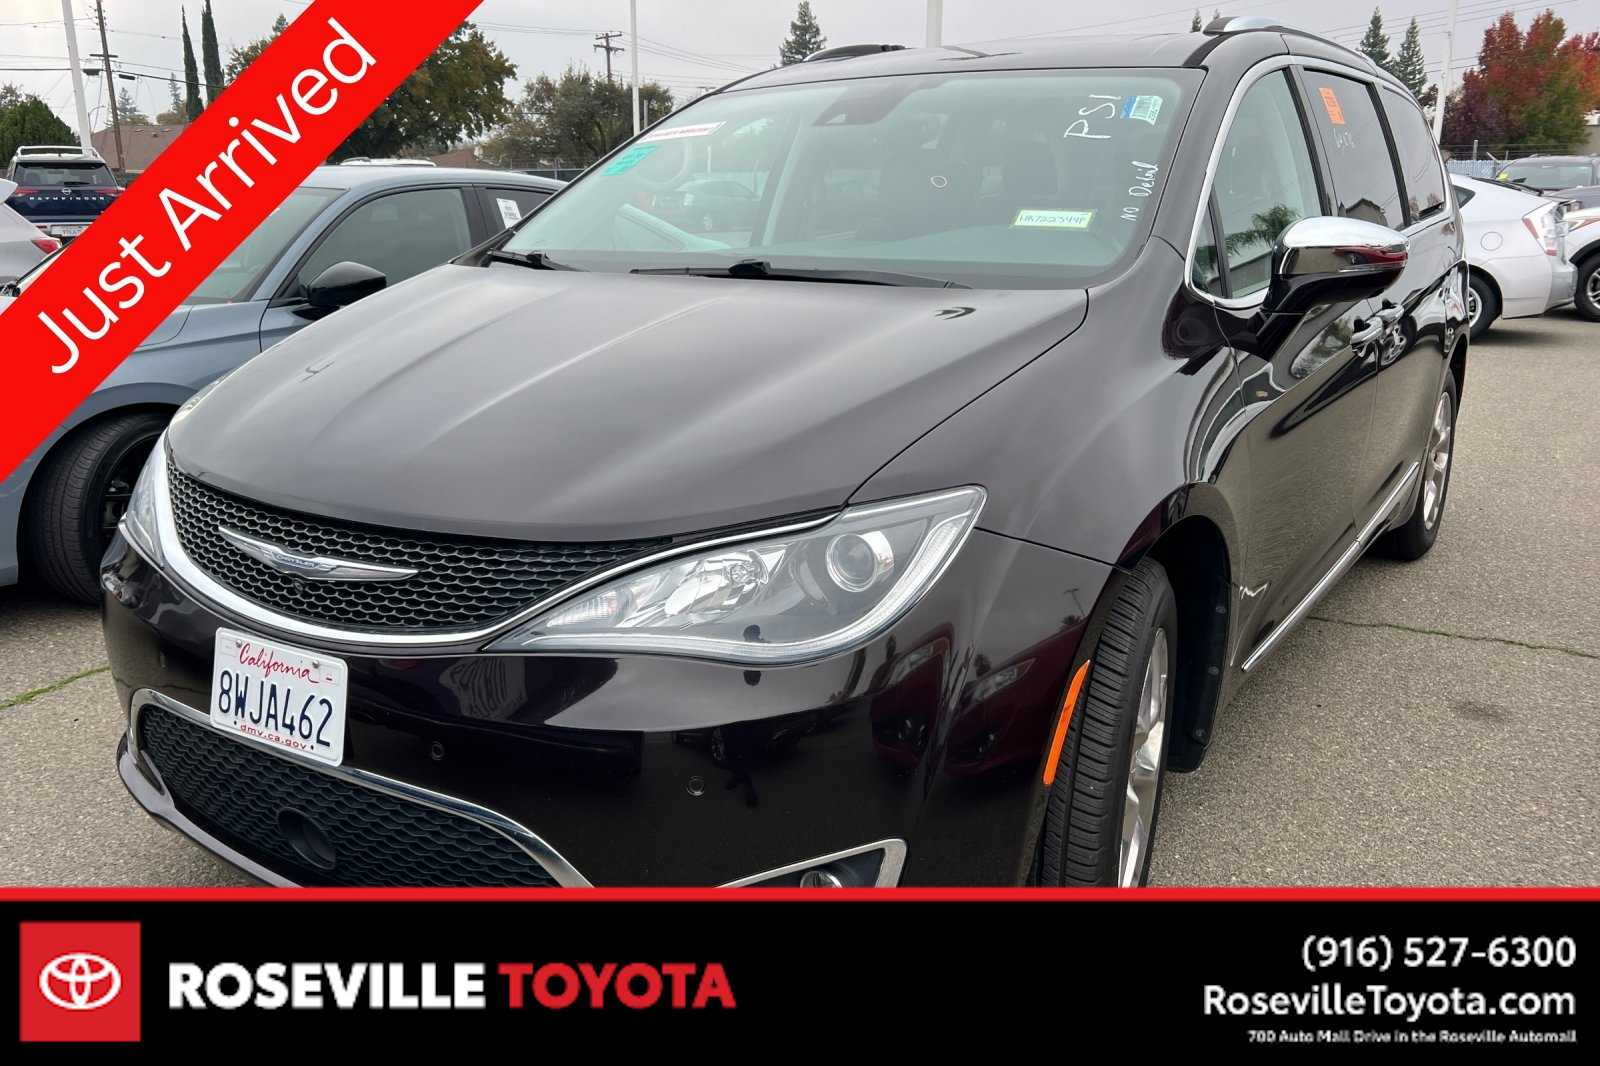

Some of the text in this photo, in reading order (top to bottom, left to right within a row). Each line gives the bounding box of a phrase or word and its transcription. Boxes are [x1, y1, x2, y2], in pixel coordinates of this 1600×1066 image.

[240, 642, 319, 684] California
[219, 670, 333, 748] 8WJA462
[240, 724, 307, 750] dmv.ca.gov
